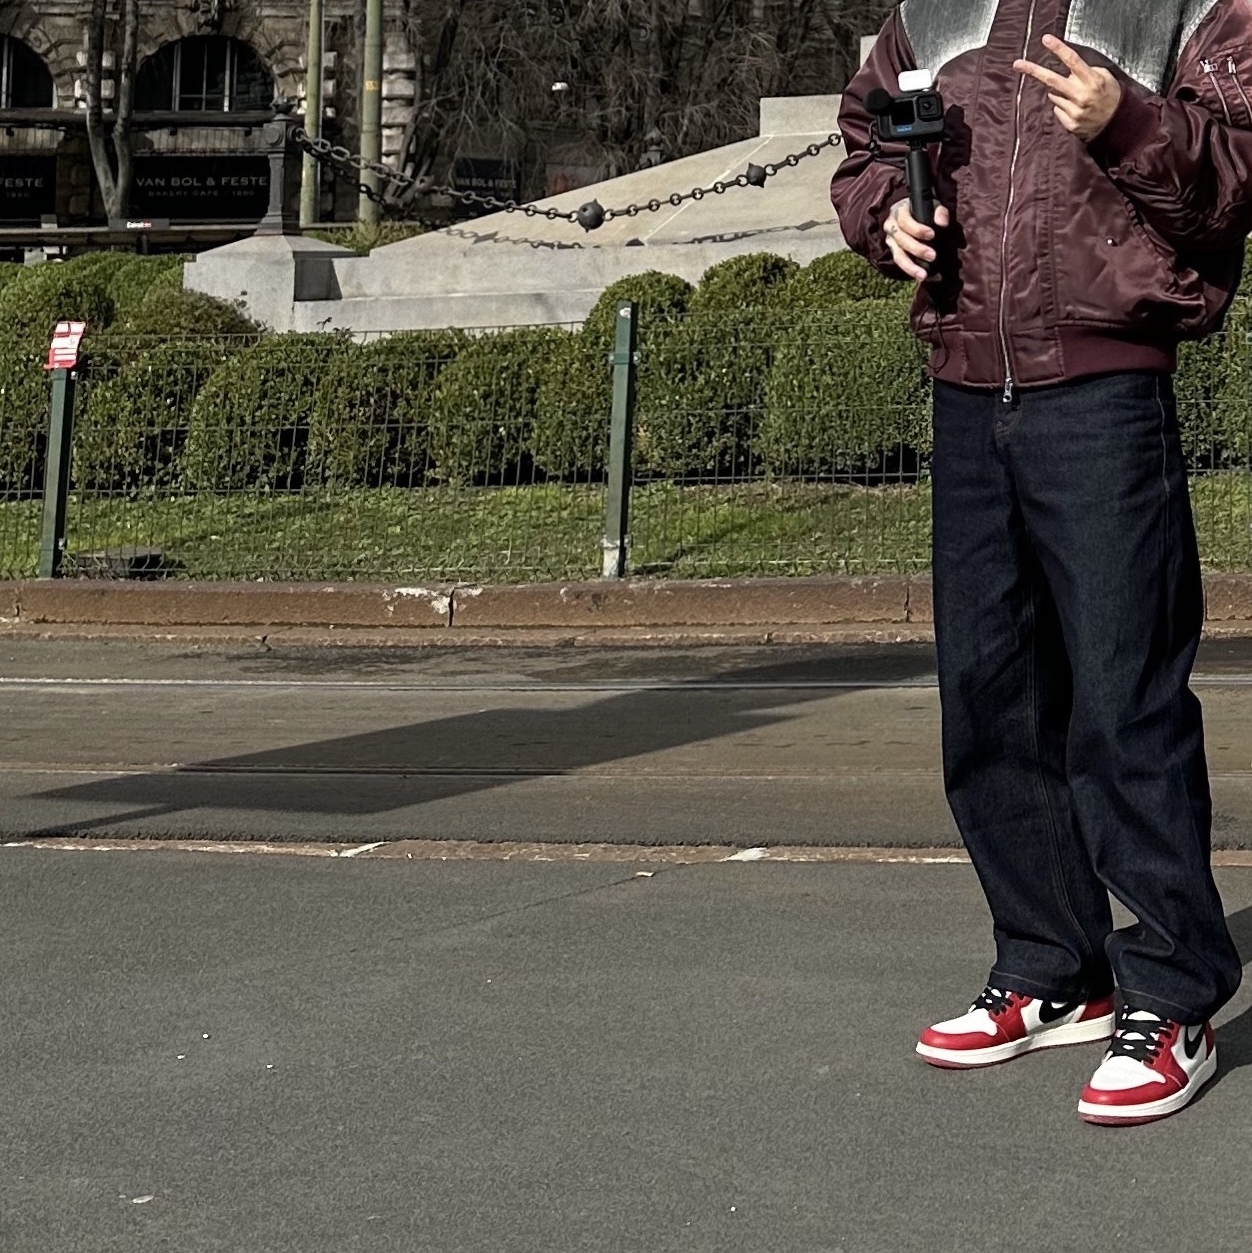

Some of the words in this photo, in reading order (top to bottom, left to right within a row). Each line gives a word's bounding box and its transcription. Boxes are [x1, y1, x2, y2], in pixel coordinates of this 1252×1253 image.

[136, 177, 166, 187] VAN
[170, 176, 202, 187] BOL
[206, 177, 216, 186] &
[221, 176, 268, 186] FESTE
